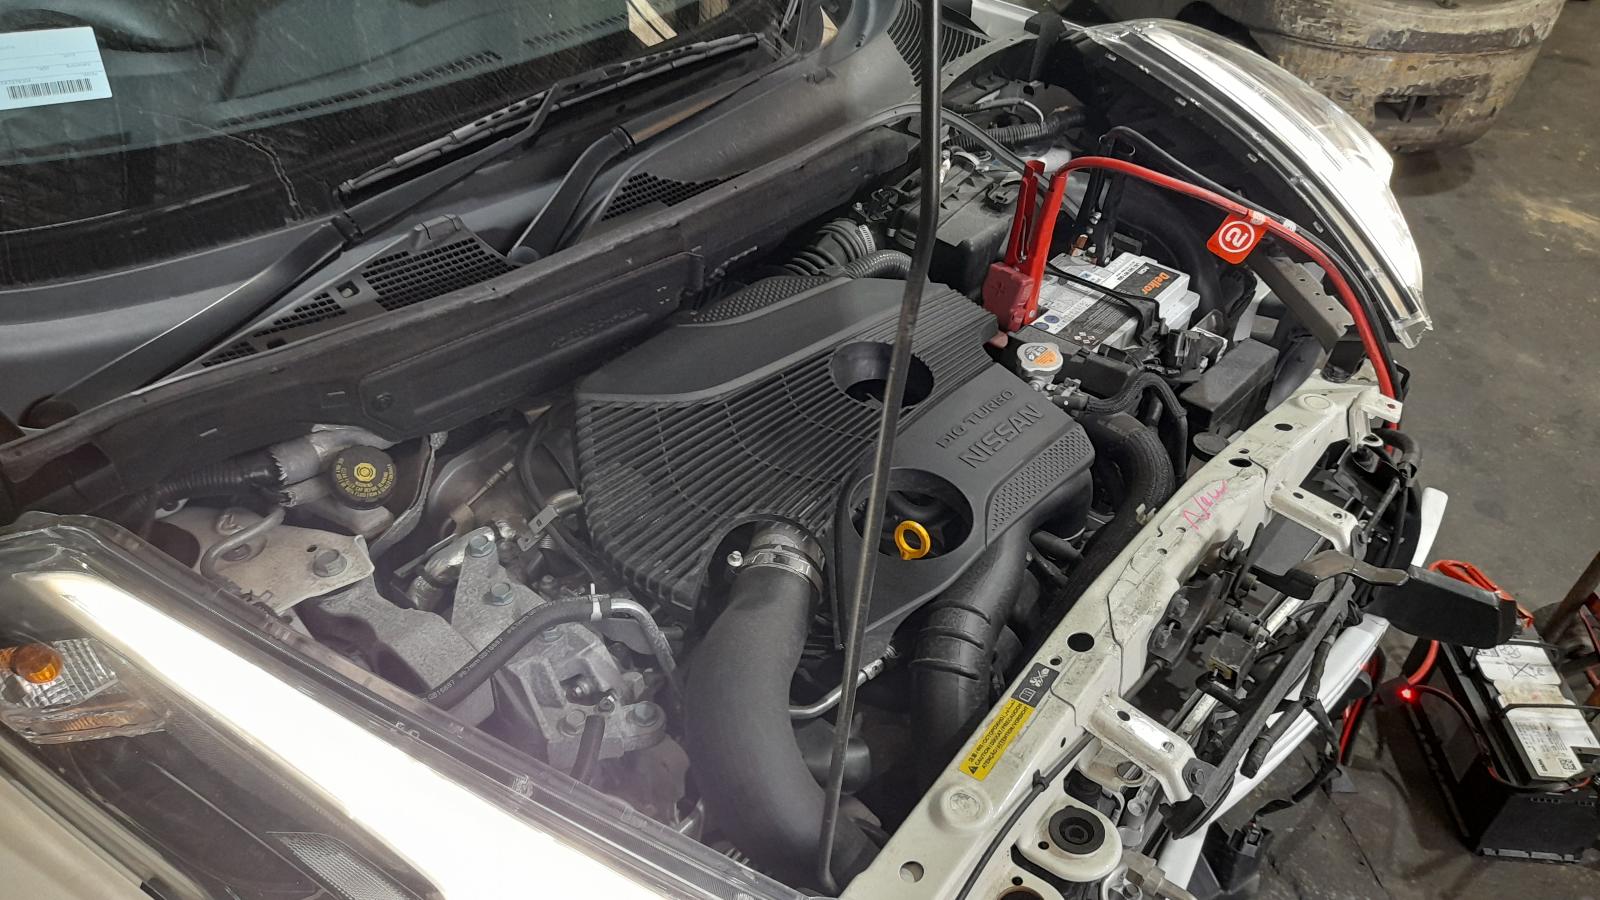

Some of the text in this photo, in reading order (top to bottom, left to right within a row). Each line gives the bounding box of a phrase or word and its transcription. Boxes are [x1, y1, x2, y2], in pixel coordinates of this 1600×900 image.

[1141, 271, 1170, 295] Delkor
[935, 388, 1016, 449] DIG TURBO
[958, 404, 1044, 469] NISSAN
[975, 746, 991, 767] CAUTION
